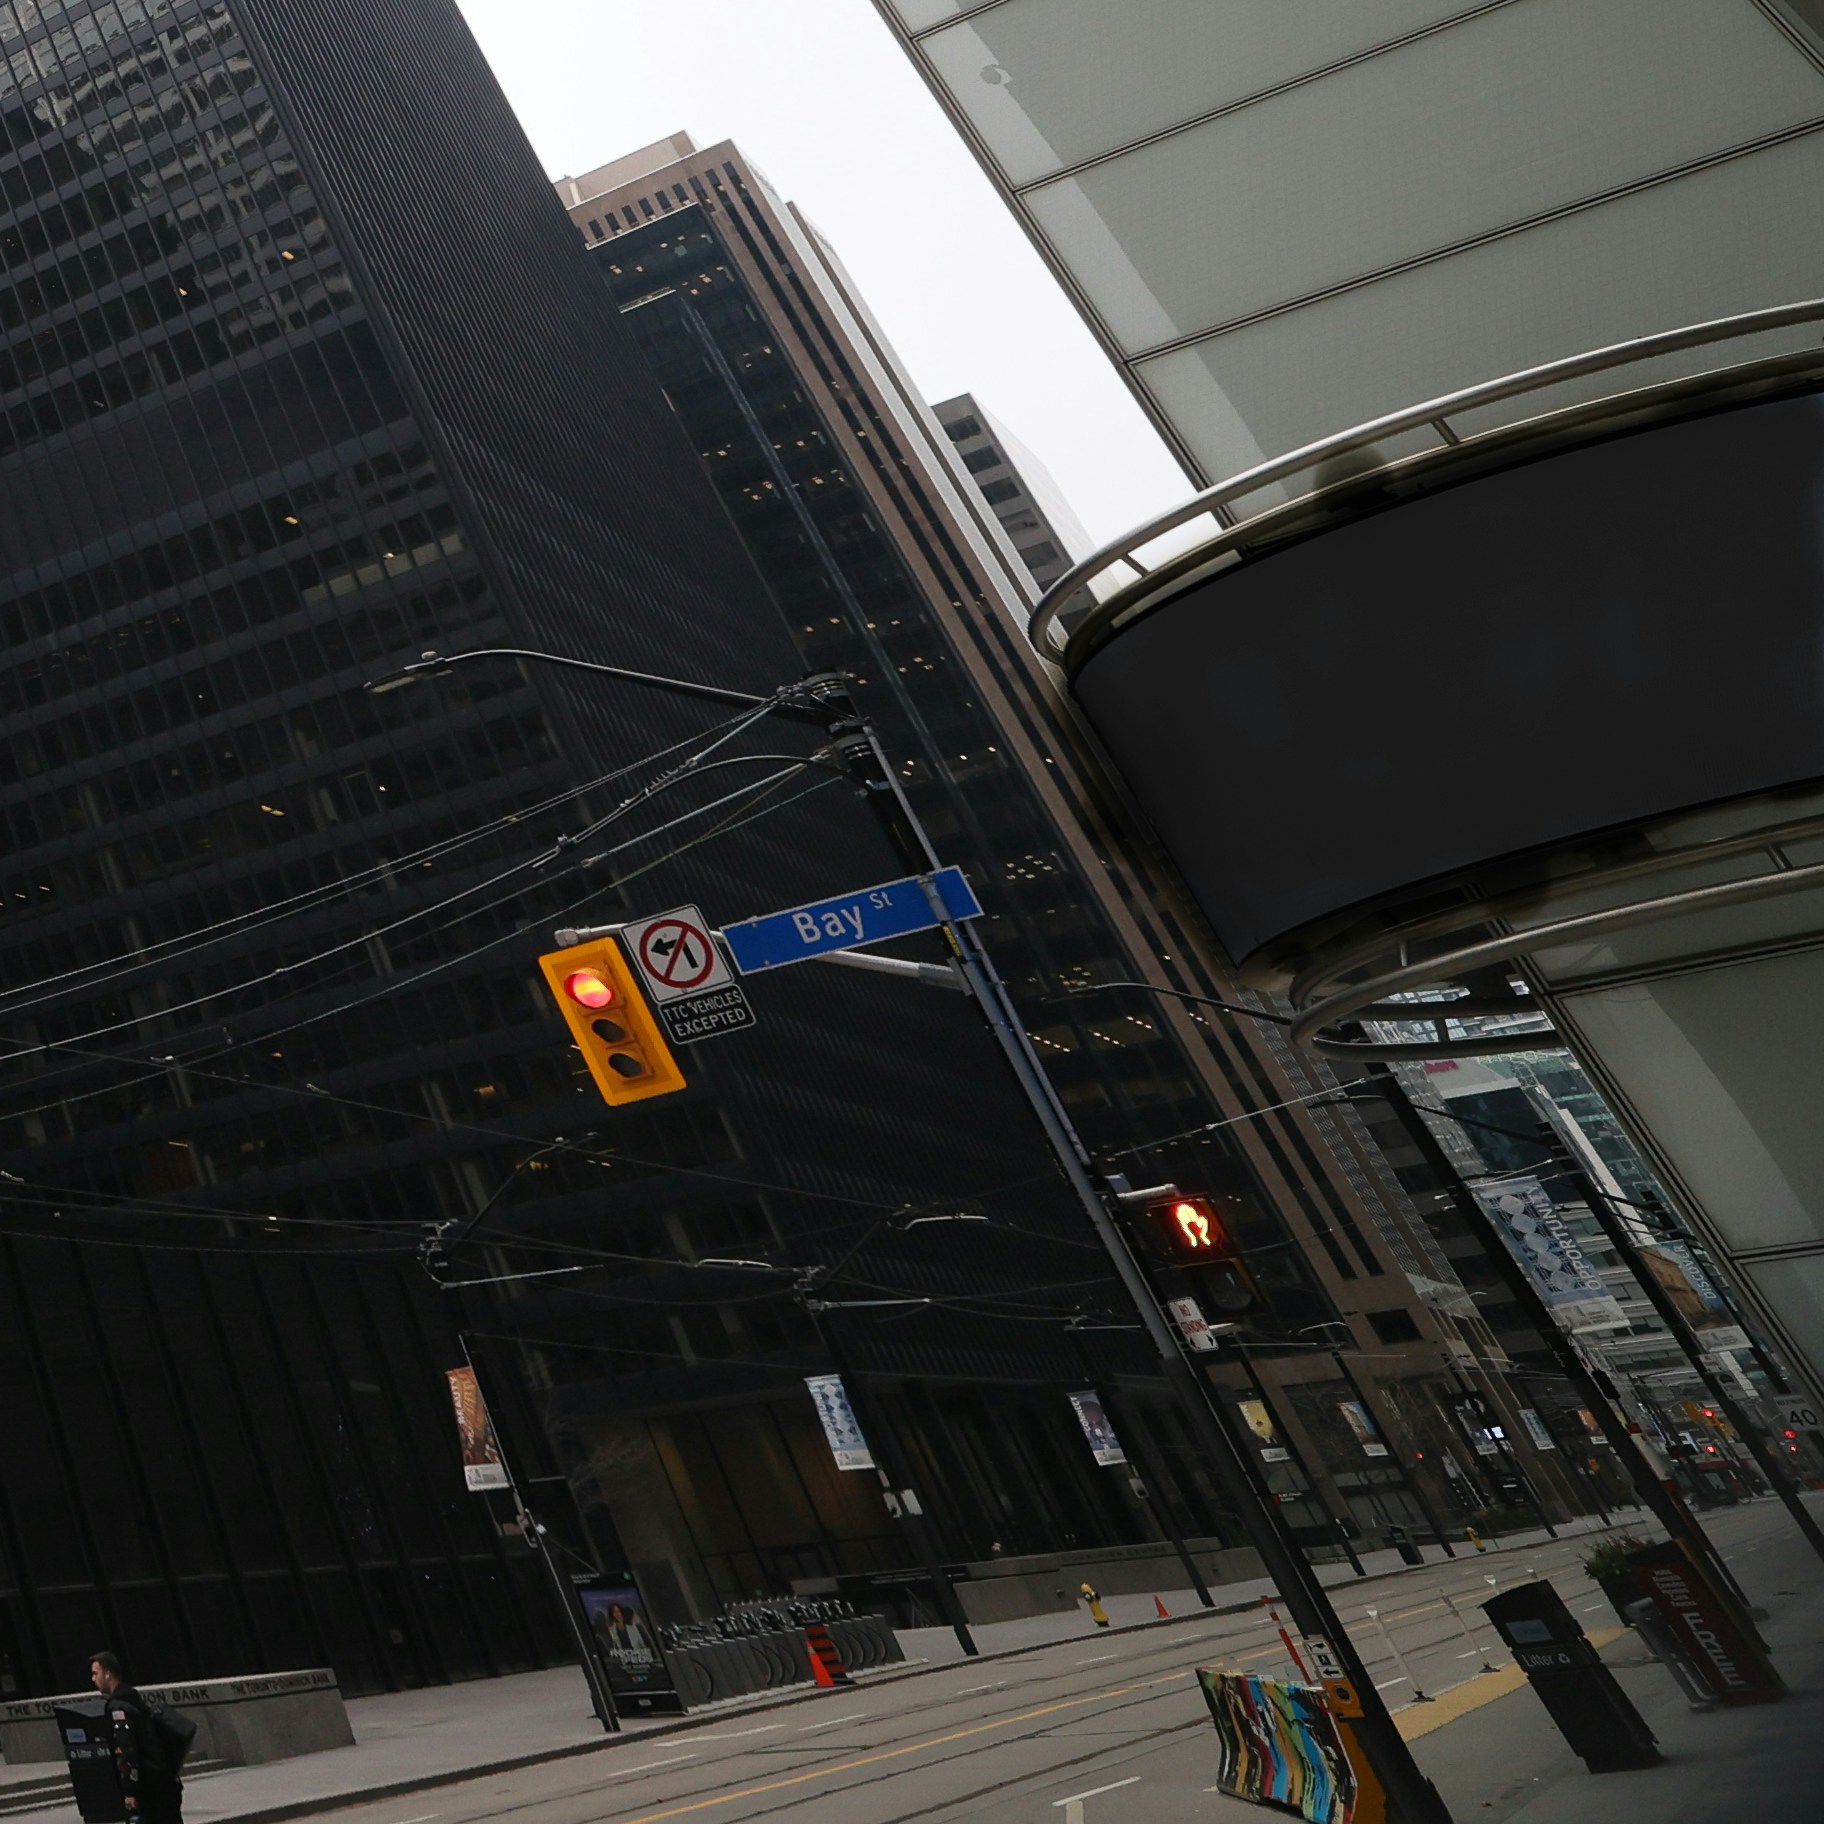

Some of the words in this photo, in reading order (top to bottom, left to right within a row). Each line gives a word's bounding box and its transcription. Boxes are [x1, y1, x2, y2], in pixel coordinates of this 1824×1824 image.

[792, 905, 865, 944] Bay
[869, 891, 893, 911] St
[663, 1004, 688, 1023] TTC
[690, 989, 743, 1015] VEHICLES
[674, 1008, 746, 1038] EXCEPTED
[1527, 1185, 1602, 1291] OPPORTUNITY
[1673, 1244, 1717, 1299] DISCOVER
[1788, 1408, 1818, 1427] 40
[1521, 1653, 1554, 1668] Litter
[6, 1704, 29, 1717] THE
[172, 1688, 210, 1703] BANK
